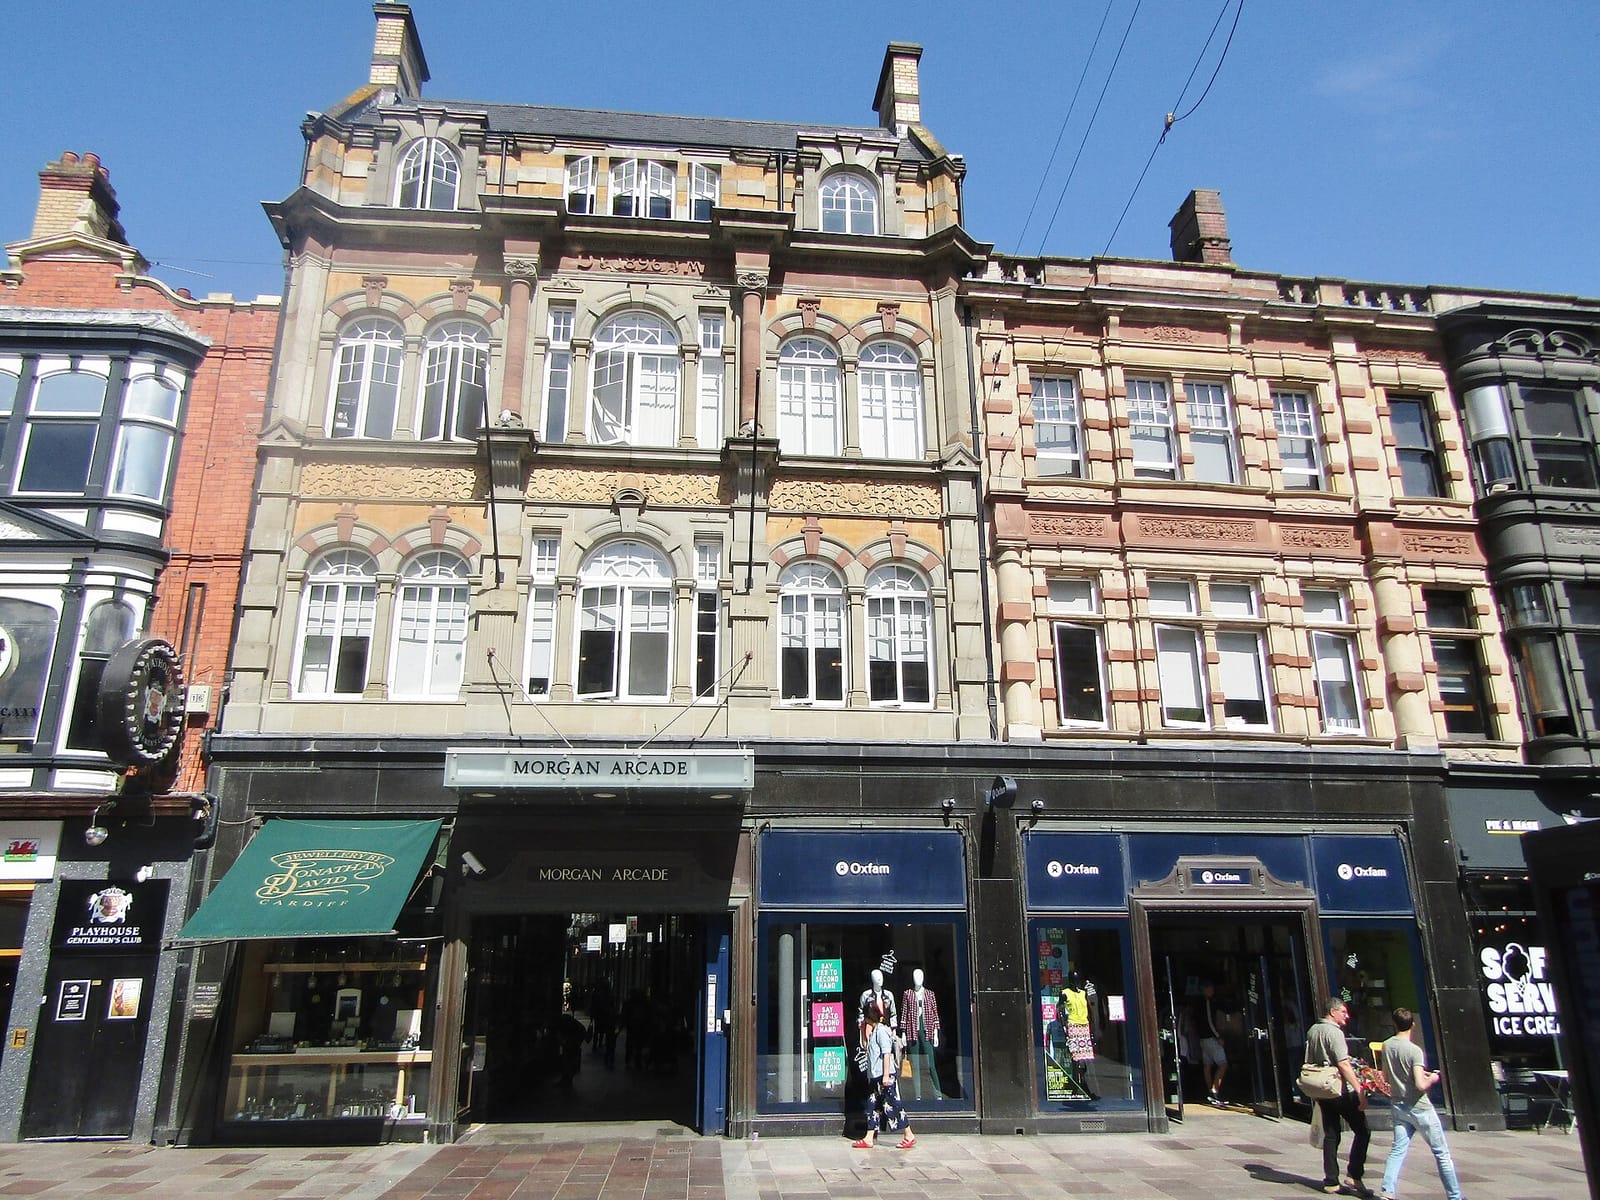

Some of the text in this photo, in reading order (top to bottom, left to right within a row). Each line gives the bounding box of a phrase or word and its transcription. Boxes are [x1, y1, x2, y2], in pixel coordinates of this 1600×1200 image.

[513, 761, 688, 776] MORGAN ARCADE
[286, 850, 384, 863] JEWELLERY BY
[279, 860, 384, 884] JONATHAN
[539, 868, 670, 880] MORGAN ARCADE
[850, 862, 890, 875] Oxfam
[1064, 863, 1099, 875] Oxfam
[1353, 866, 1387, 877] Oxfam
[1214, 872, 1241, 881] Oxfam
[256, 874, 348, 899] DAVID
[259, 899, 349, 907] CARDIFF
[72, 927, 140, 936] PLAYHOUSE
[121, 936, 143, 944] CLUB
[1493, 1015, 1561, 1035] ICE CRE
